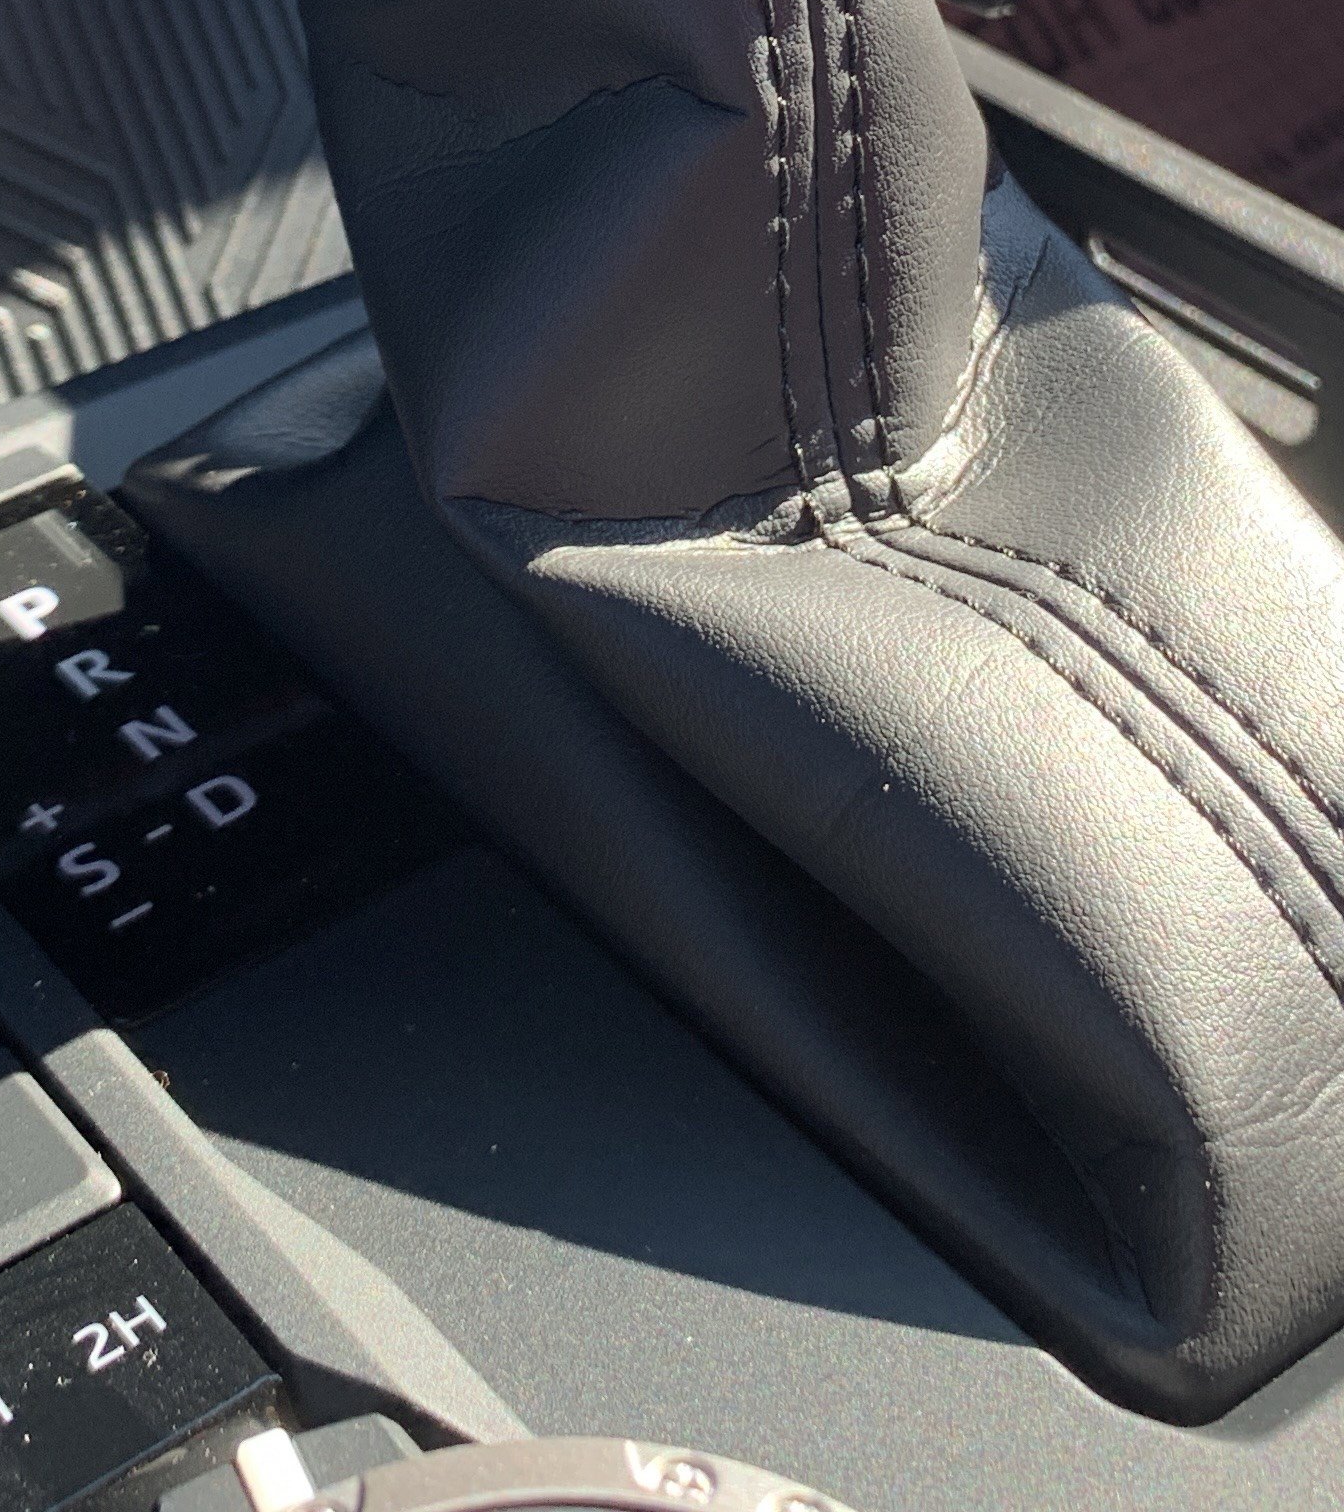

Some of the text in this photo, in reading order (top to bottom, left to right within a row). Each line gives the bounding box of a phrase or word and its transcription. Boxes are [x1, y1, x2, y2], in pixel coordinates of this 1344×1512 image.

[57, 649, 136, 701] R
[119, 704, 199, 762] N
[58, 841, 121, 897] S
[186, 775, 257, 829] D
[72, 1294, 167, 1372] 2H
